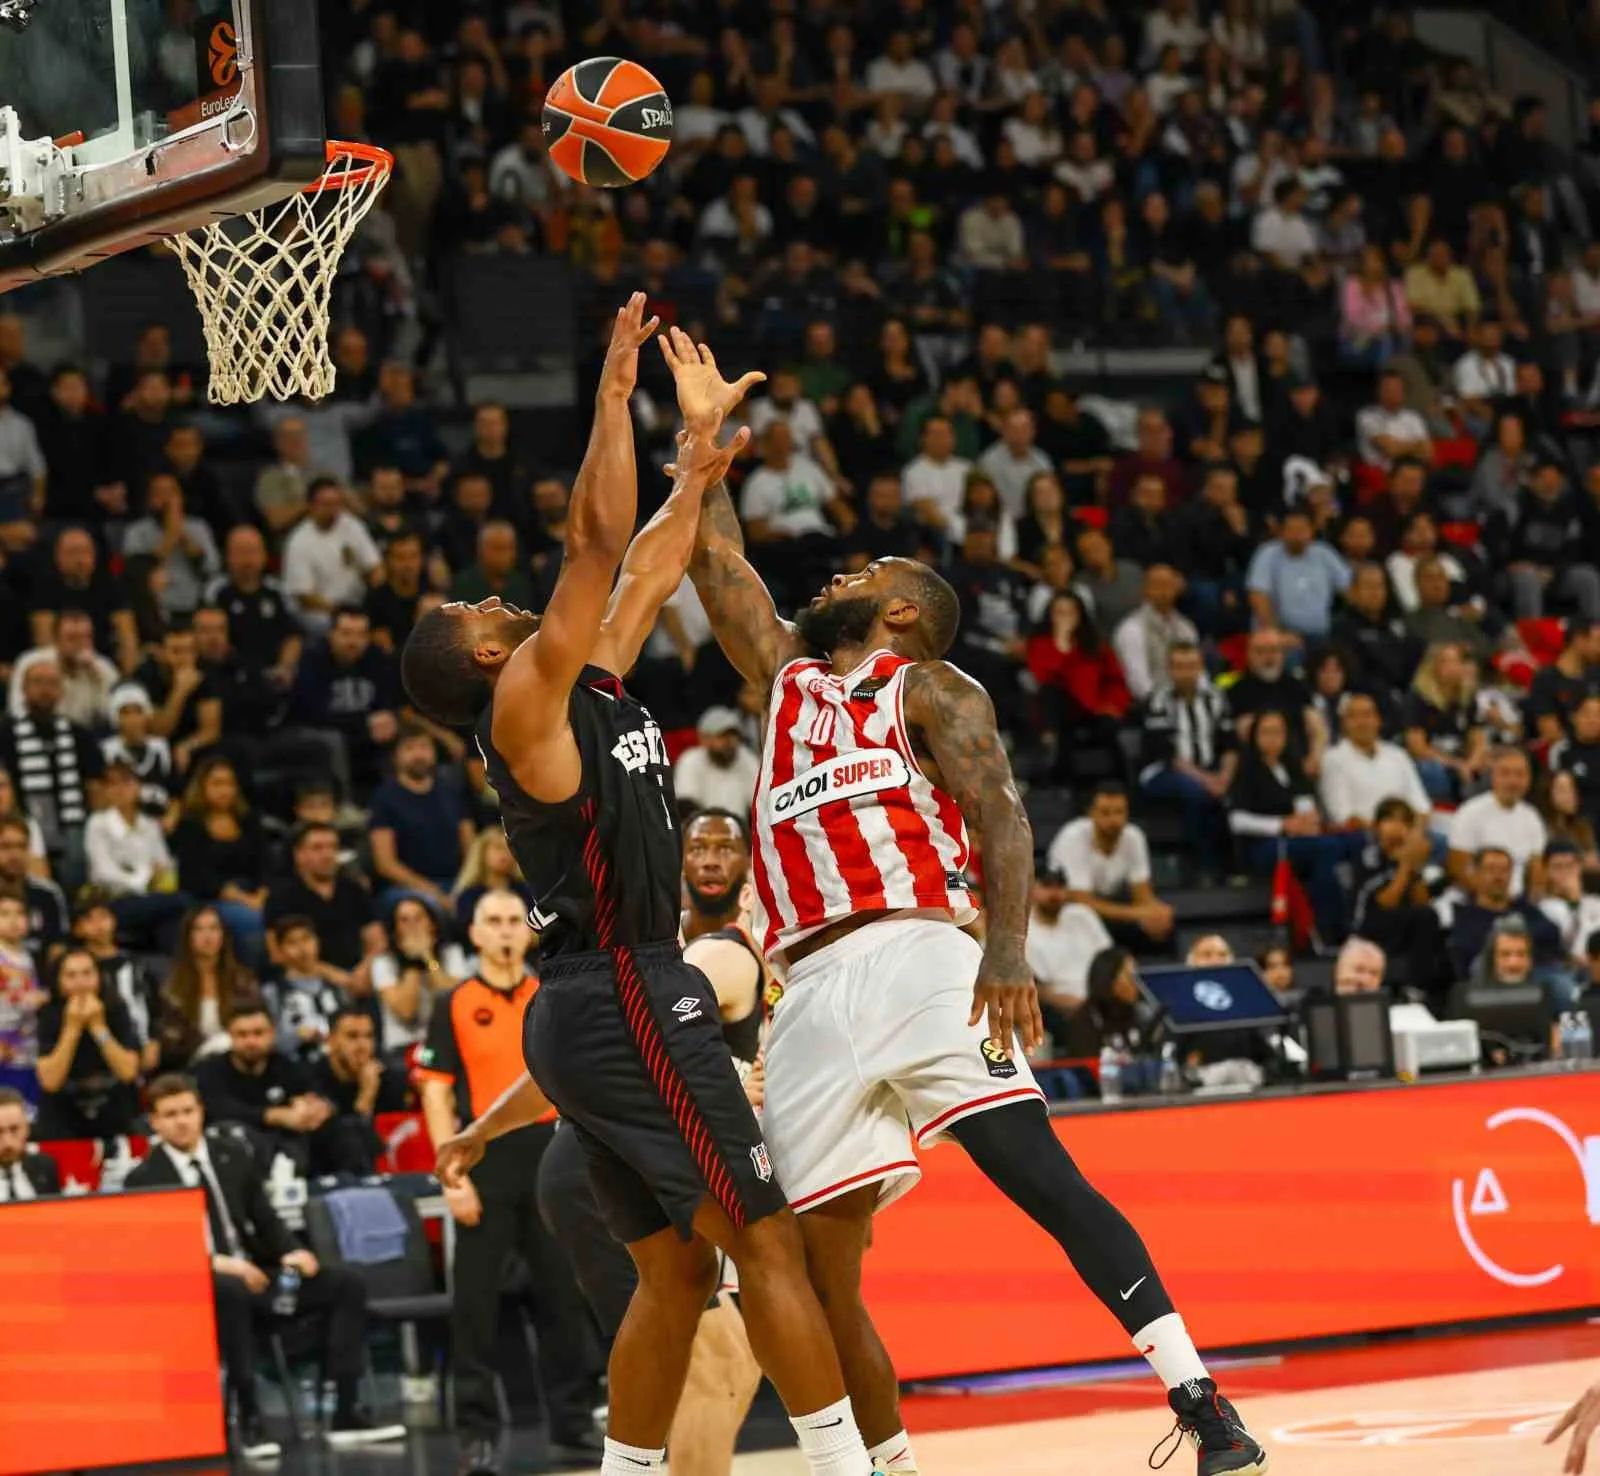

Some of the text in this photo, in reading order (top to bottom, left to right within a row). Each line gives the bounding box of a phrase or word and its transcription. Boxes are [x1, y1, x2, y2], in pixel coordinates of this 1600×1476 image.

[201, 95, 235, 117] EuroLea
[641, 107, 673, 129] SPAL
[832, 757, 893, 789] SUPER
